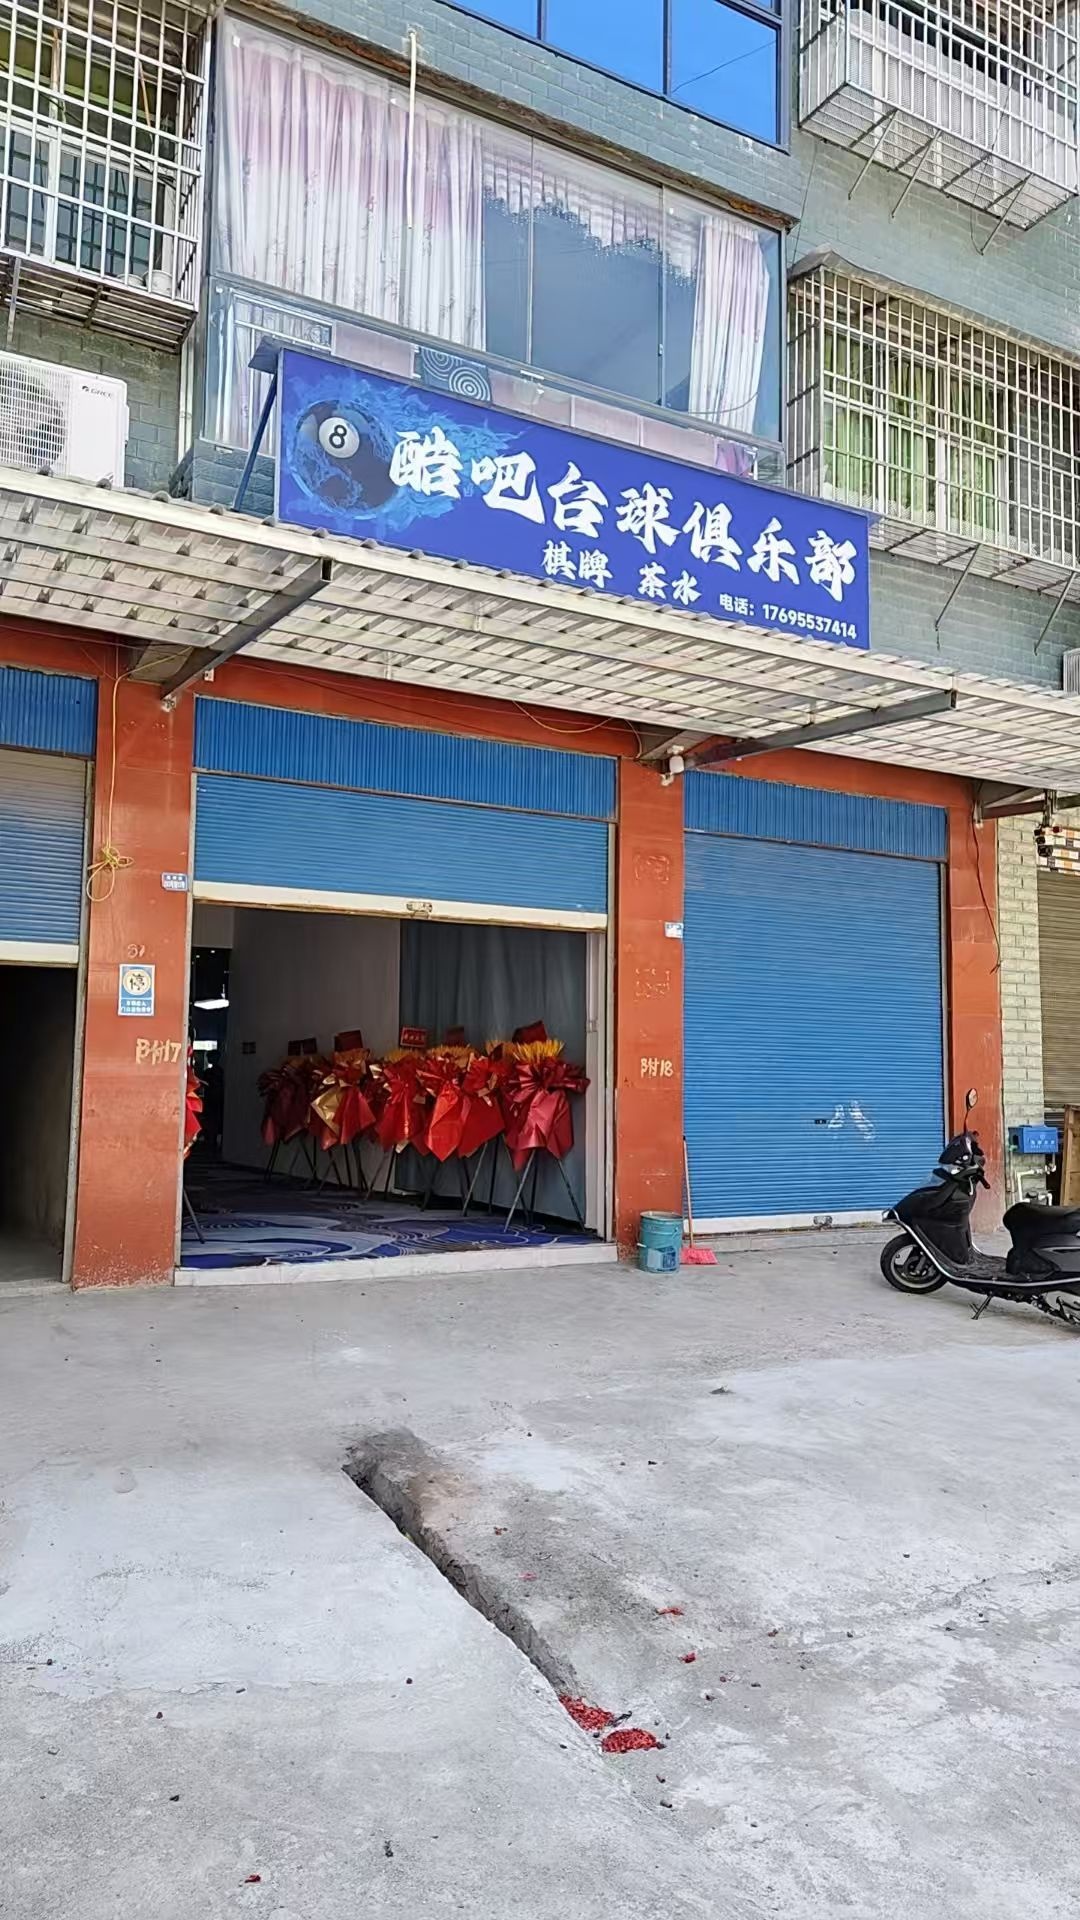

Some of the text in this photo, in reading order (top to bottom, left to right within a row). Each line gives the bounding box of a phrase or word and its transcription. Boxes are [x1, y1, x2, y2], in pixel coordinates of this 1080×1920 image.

[329, 424, 347, 449] 8
[389, 426, 857, 602] 酷吧台球俱乐部
[541, 540, 702, 605] 棋牌 茶水
